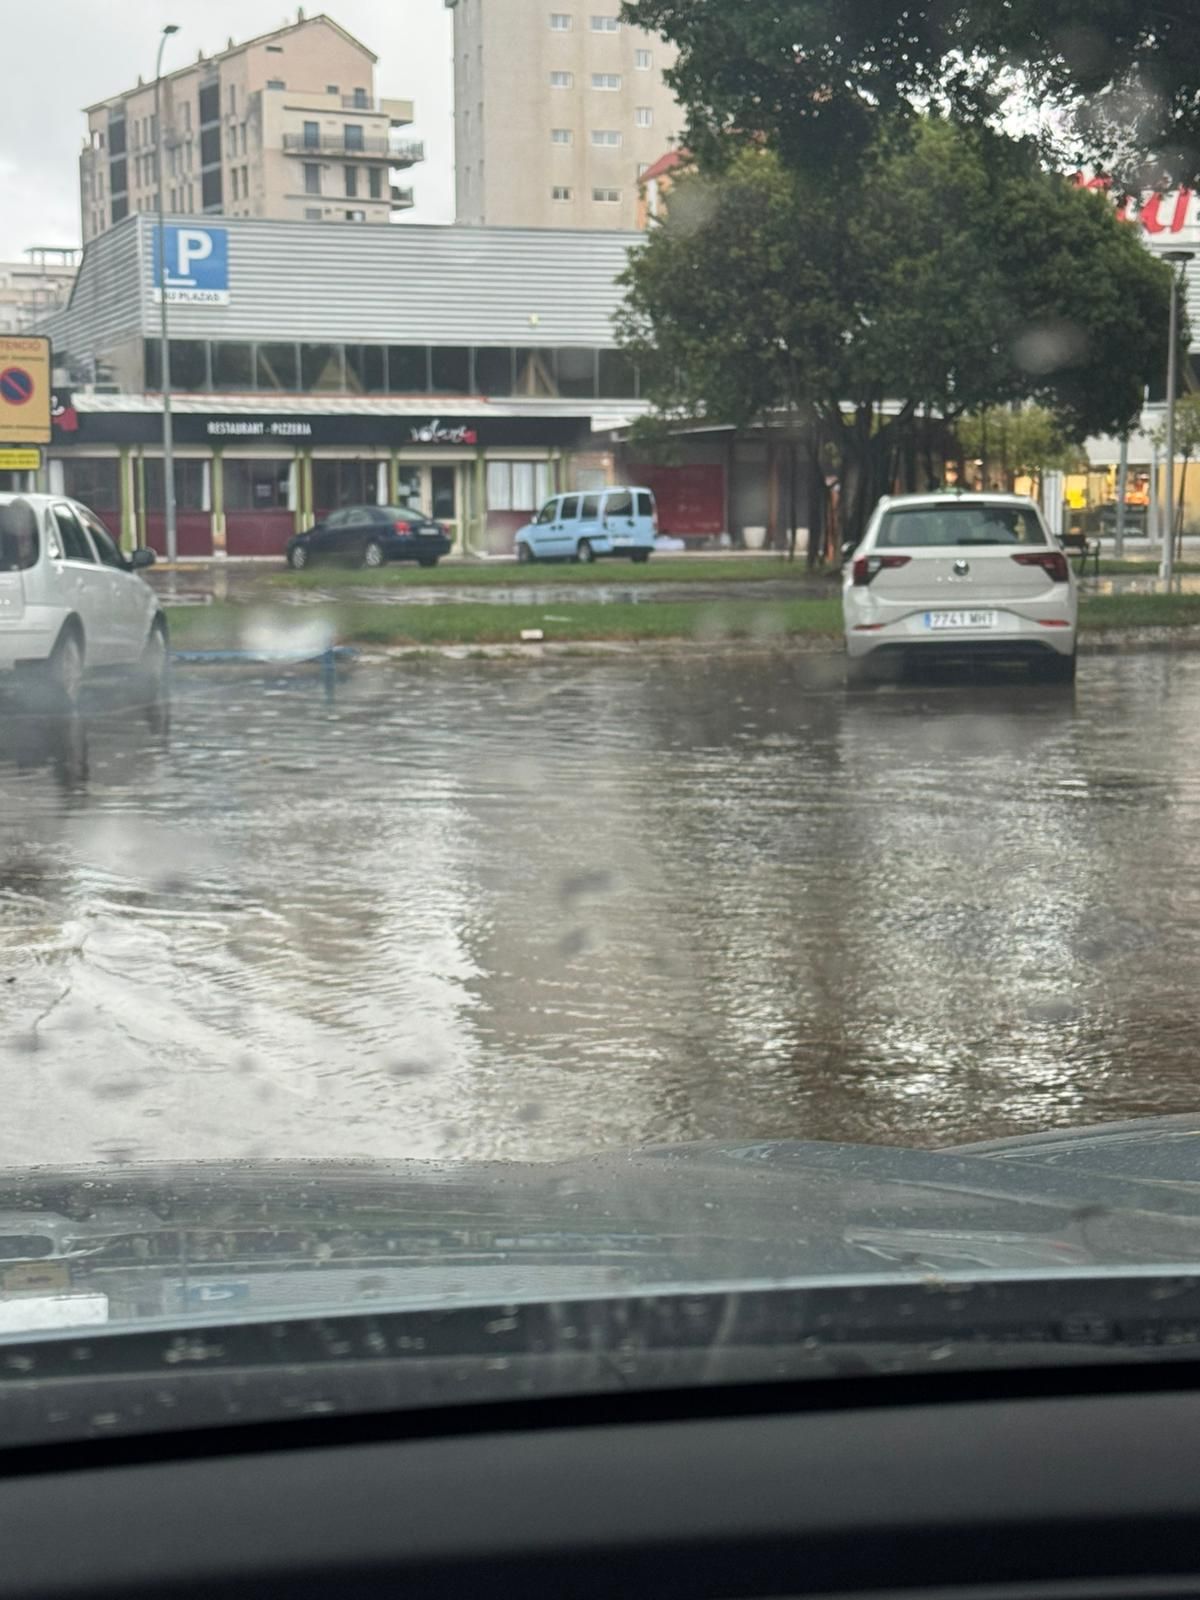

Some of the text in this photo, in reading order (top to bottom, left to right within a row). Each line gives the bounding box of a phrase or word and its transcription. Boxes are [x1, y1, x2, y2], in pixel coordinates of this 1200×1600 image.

[178, 229, 213, 275] P
[207, 421, 263, 435] RESTAURANT
[271, 422, 312, 435] PIZZERIA
